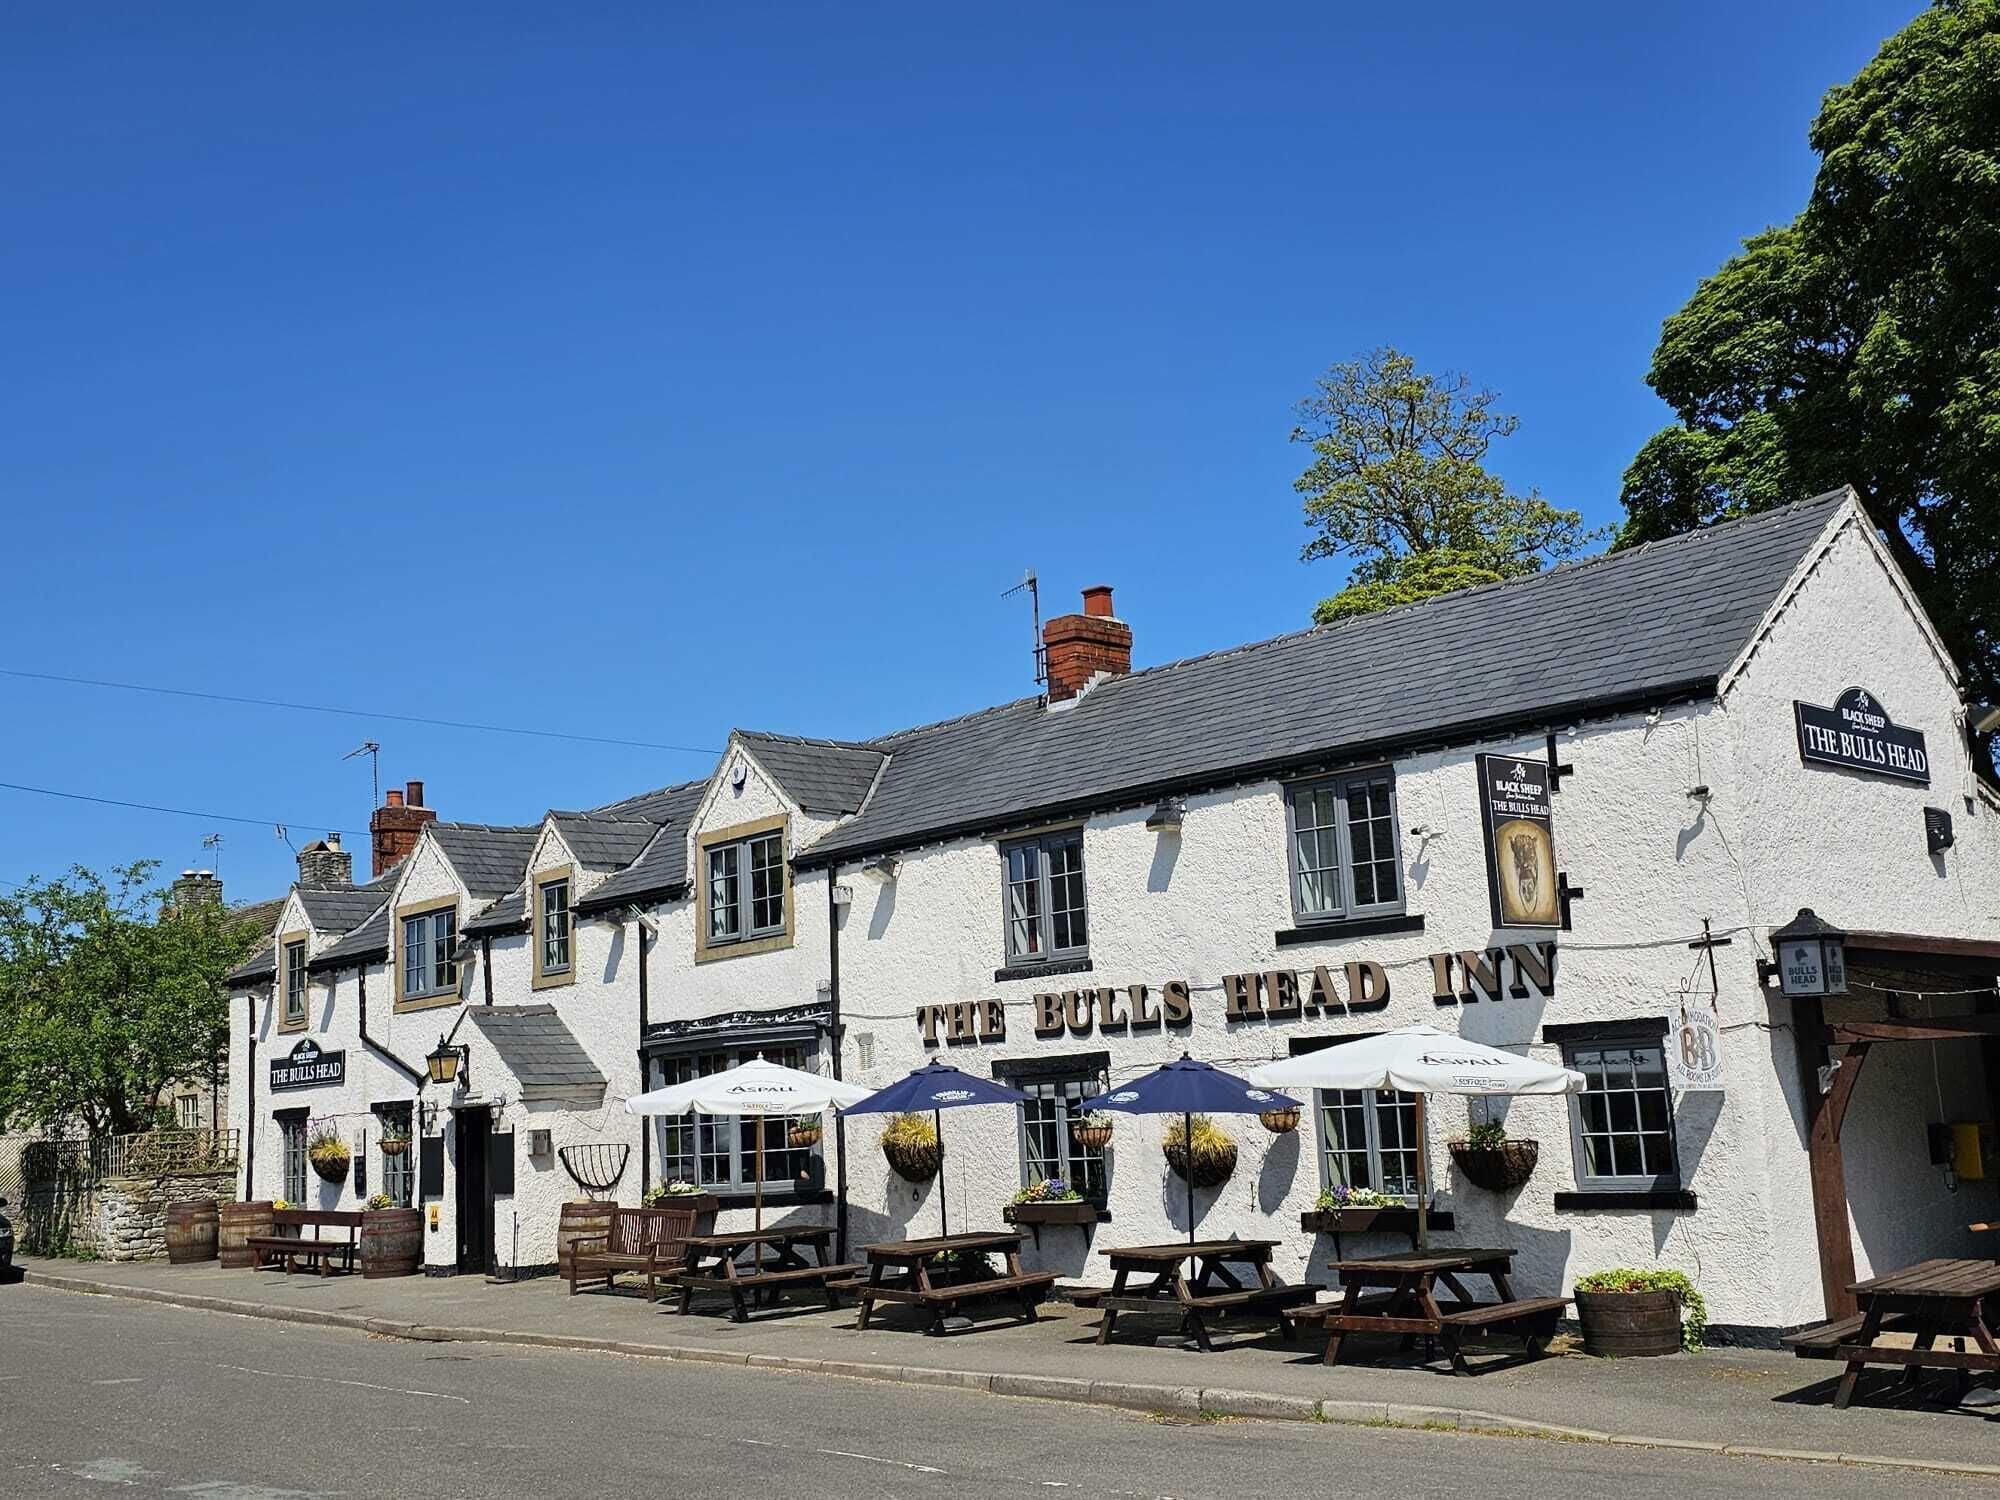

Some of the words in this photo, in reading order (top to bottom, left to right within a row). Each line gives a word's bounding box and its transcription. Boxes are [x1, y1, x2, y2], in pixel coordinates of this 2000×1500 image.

[1842, 708, 1864, 723] BLACK
[1864, 711, 1885, 729] SHEEP
[1805, 723, 1839, 755] THE
[1839, 731, 1886, 765] BULLS
[1886, 742, 1927, 772] HEAD
[1496, 780, 1520, 792] BLACK
[1519, 783, 1543, 796] SHEEP
[1492, 800, 1508, 811] THE
[1508, 801, 1530, 813] BULLS
[1530, 804, 1549, 815] HEAD
[1788, 966, 1817, 976] BULLS
[1790, 975, 1817, 985] HEAD
[917, 999, 1005, 1047] THE
[1034, 980, 1193, 1039] BULLS
[1223, 960, 1391, 1023] HEAD
[1429, 942, 1556, 1006] INN
[272, 1068, 289, 1084] THE
[289, 1065, 315, 1082] BULLS
[316, 1062, 341, 1079] HEAD
